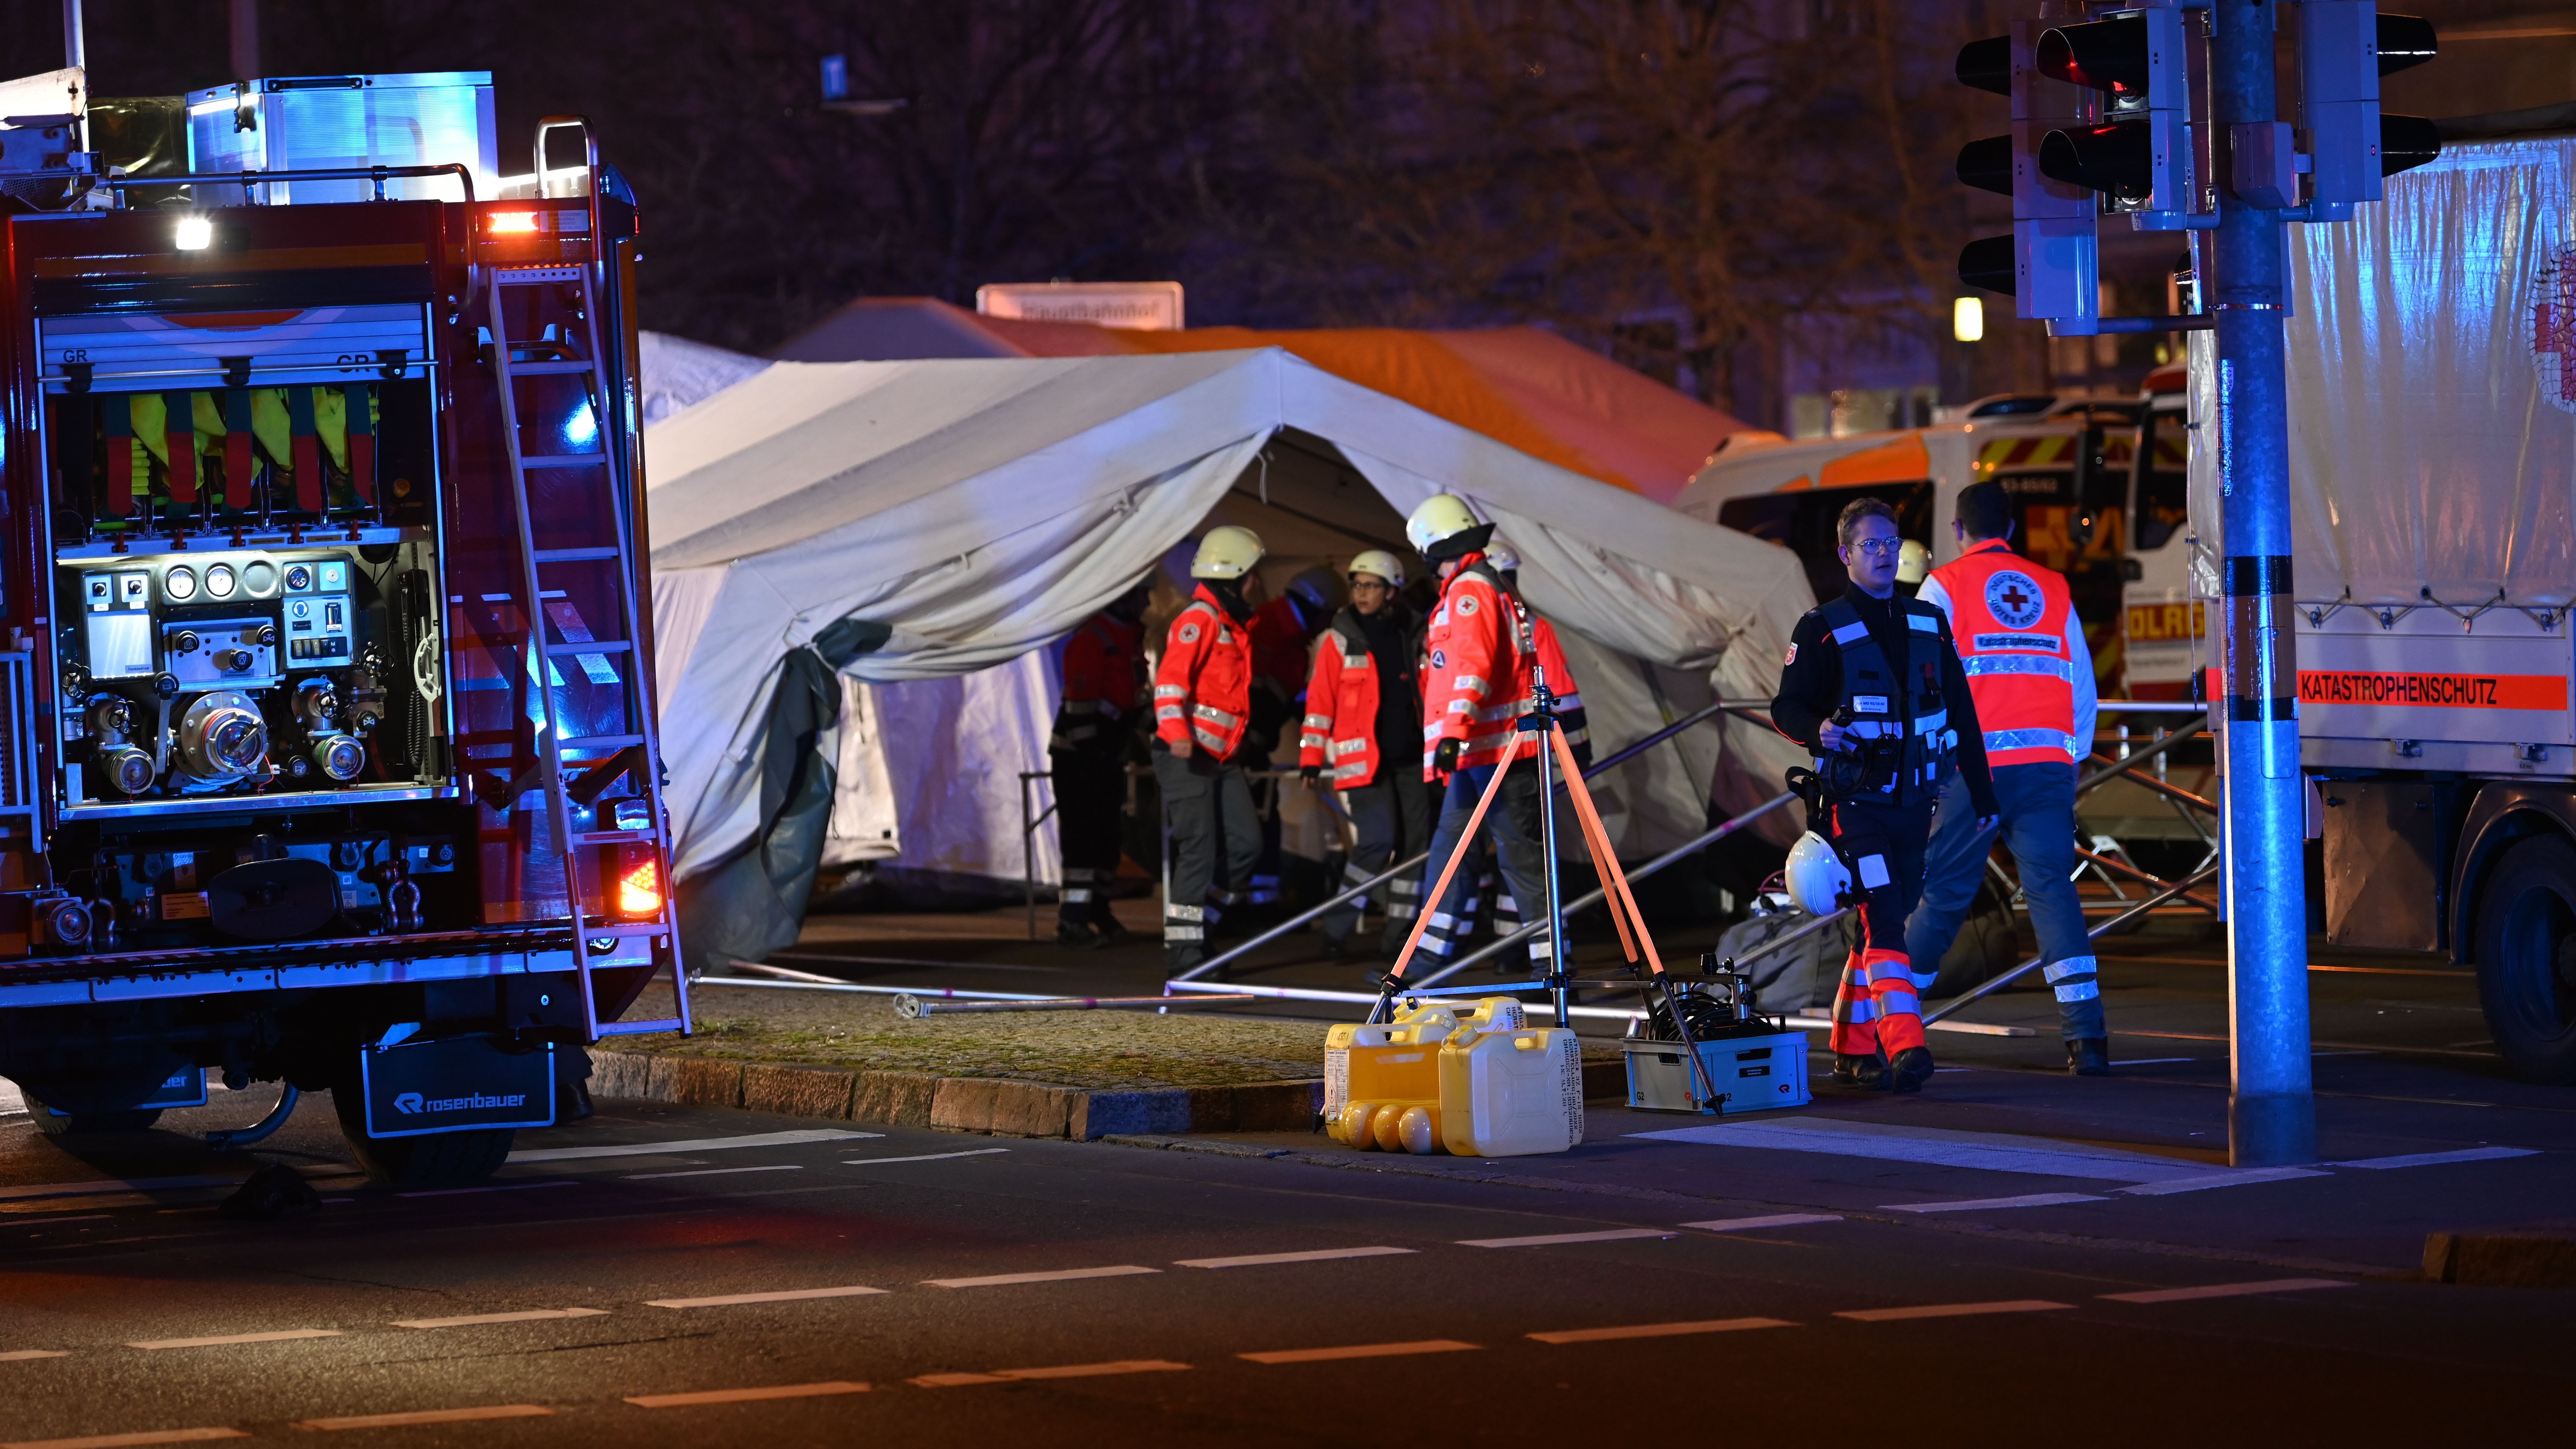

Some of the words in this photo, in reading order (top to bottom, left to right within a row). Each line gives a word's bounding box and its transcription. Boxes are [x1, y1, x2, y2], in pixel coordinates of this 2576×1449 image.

[63, 350, 87, 363] GR
[1990, 575, 2036, 595] DEUTSCHER
[2020, 601, 2040, 624] KREUZ
[2130, 604, 2205, 637] DLRG
[2301, 674, 2497, 704] KATASTROPHENSCHUTZ
[427, 1092, 526, 1113] rosenbauer
[1637, 1091, 1644, 1101] G2
